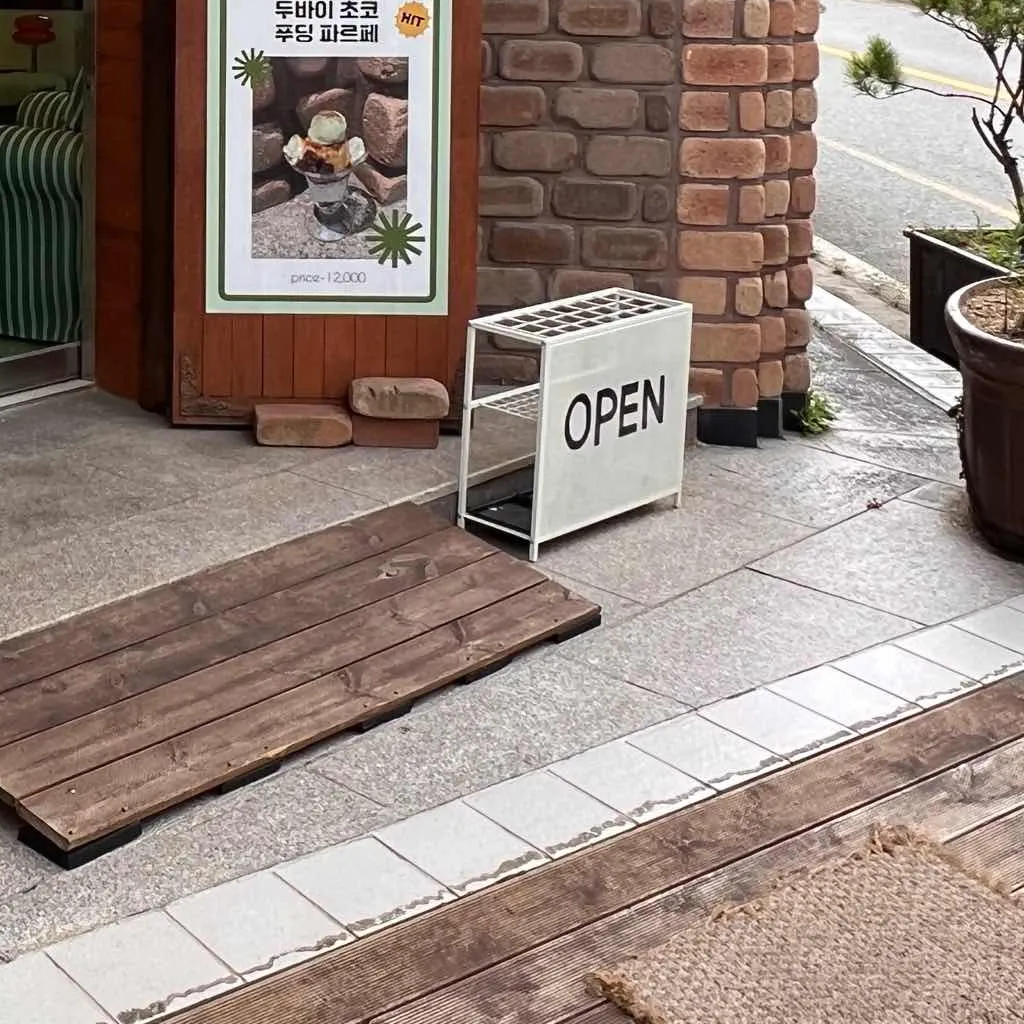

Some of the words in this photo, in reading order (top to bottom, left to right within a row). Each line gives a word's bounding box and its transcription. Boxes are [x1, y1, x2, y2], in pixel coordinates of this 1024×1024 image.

[275, 0, 333, 19] 두바이
[339, 0, 379, 19] 초코
[400, 12, 425, 27] HIT
[275, 24, 313, 43] 푸딩
[319, 24, 379, 43] 파르페
[564, 374, 666, 451] OPEN
